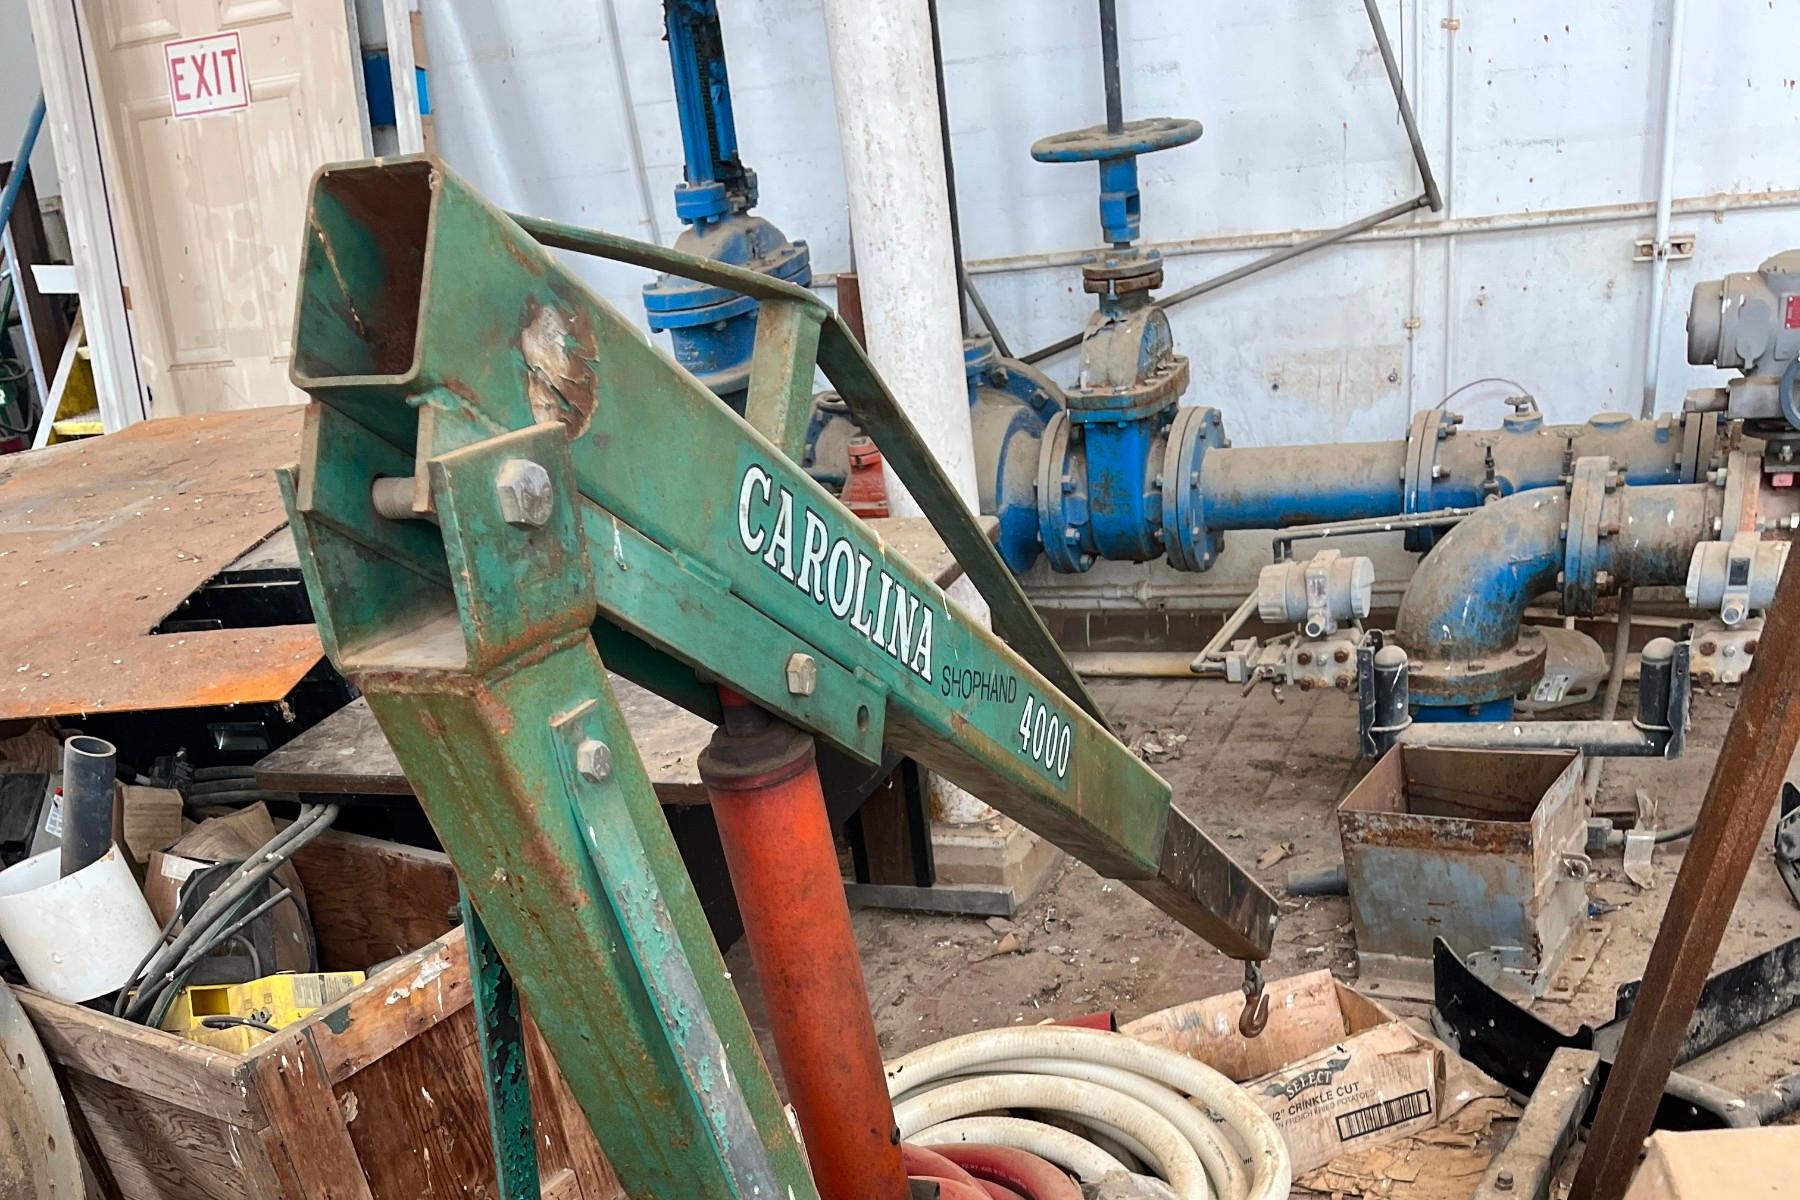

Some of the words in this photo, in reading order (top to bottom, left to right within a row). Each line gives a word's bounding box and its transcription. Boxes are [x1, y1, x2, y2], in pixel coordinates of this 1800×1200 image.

[171, 48, 236, 101] EXIT
[738, 463, 934, 684] CAROLINA
[941, 664, 1018, 705] SHOPHAND
[1018, 693, 1072, 780] 4000
[1286, 1070, 1332, 1098] SELECT
[1288, 1091, 1334, 1115] CRINKLE
[1336, 1081, 1360, 1097] CUT
